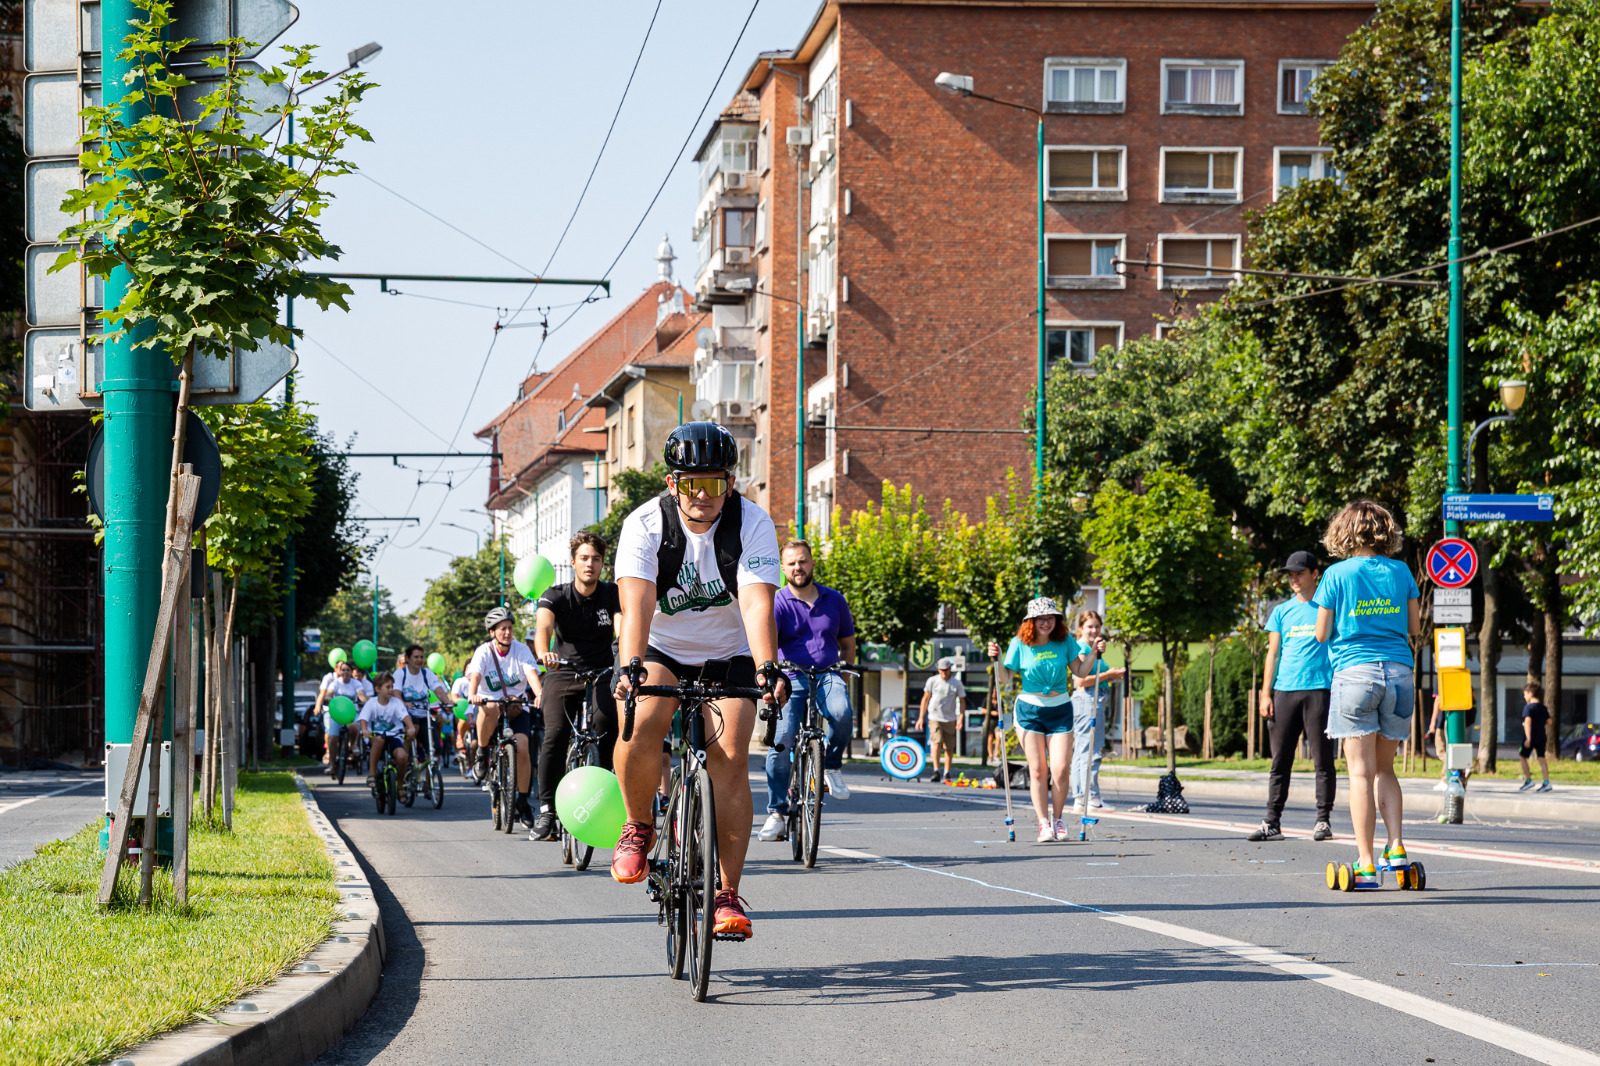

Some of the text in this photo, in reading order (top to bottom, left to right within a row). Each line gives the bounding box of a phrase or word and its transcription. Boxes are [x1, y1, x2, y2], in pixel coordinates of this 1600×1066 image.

[1447, 511, 1506, 520] Piața Huniade
[1357, 598, 1391, 609] JUNIOR
[1348, 606, 1401, 617] ADVENTURE
